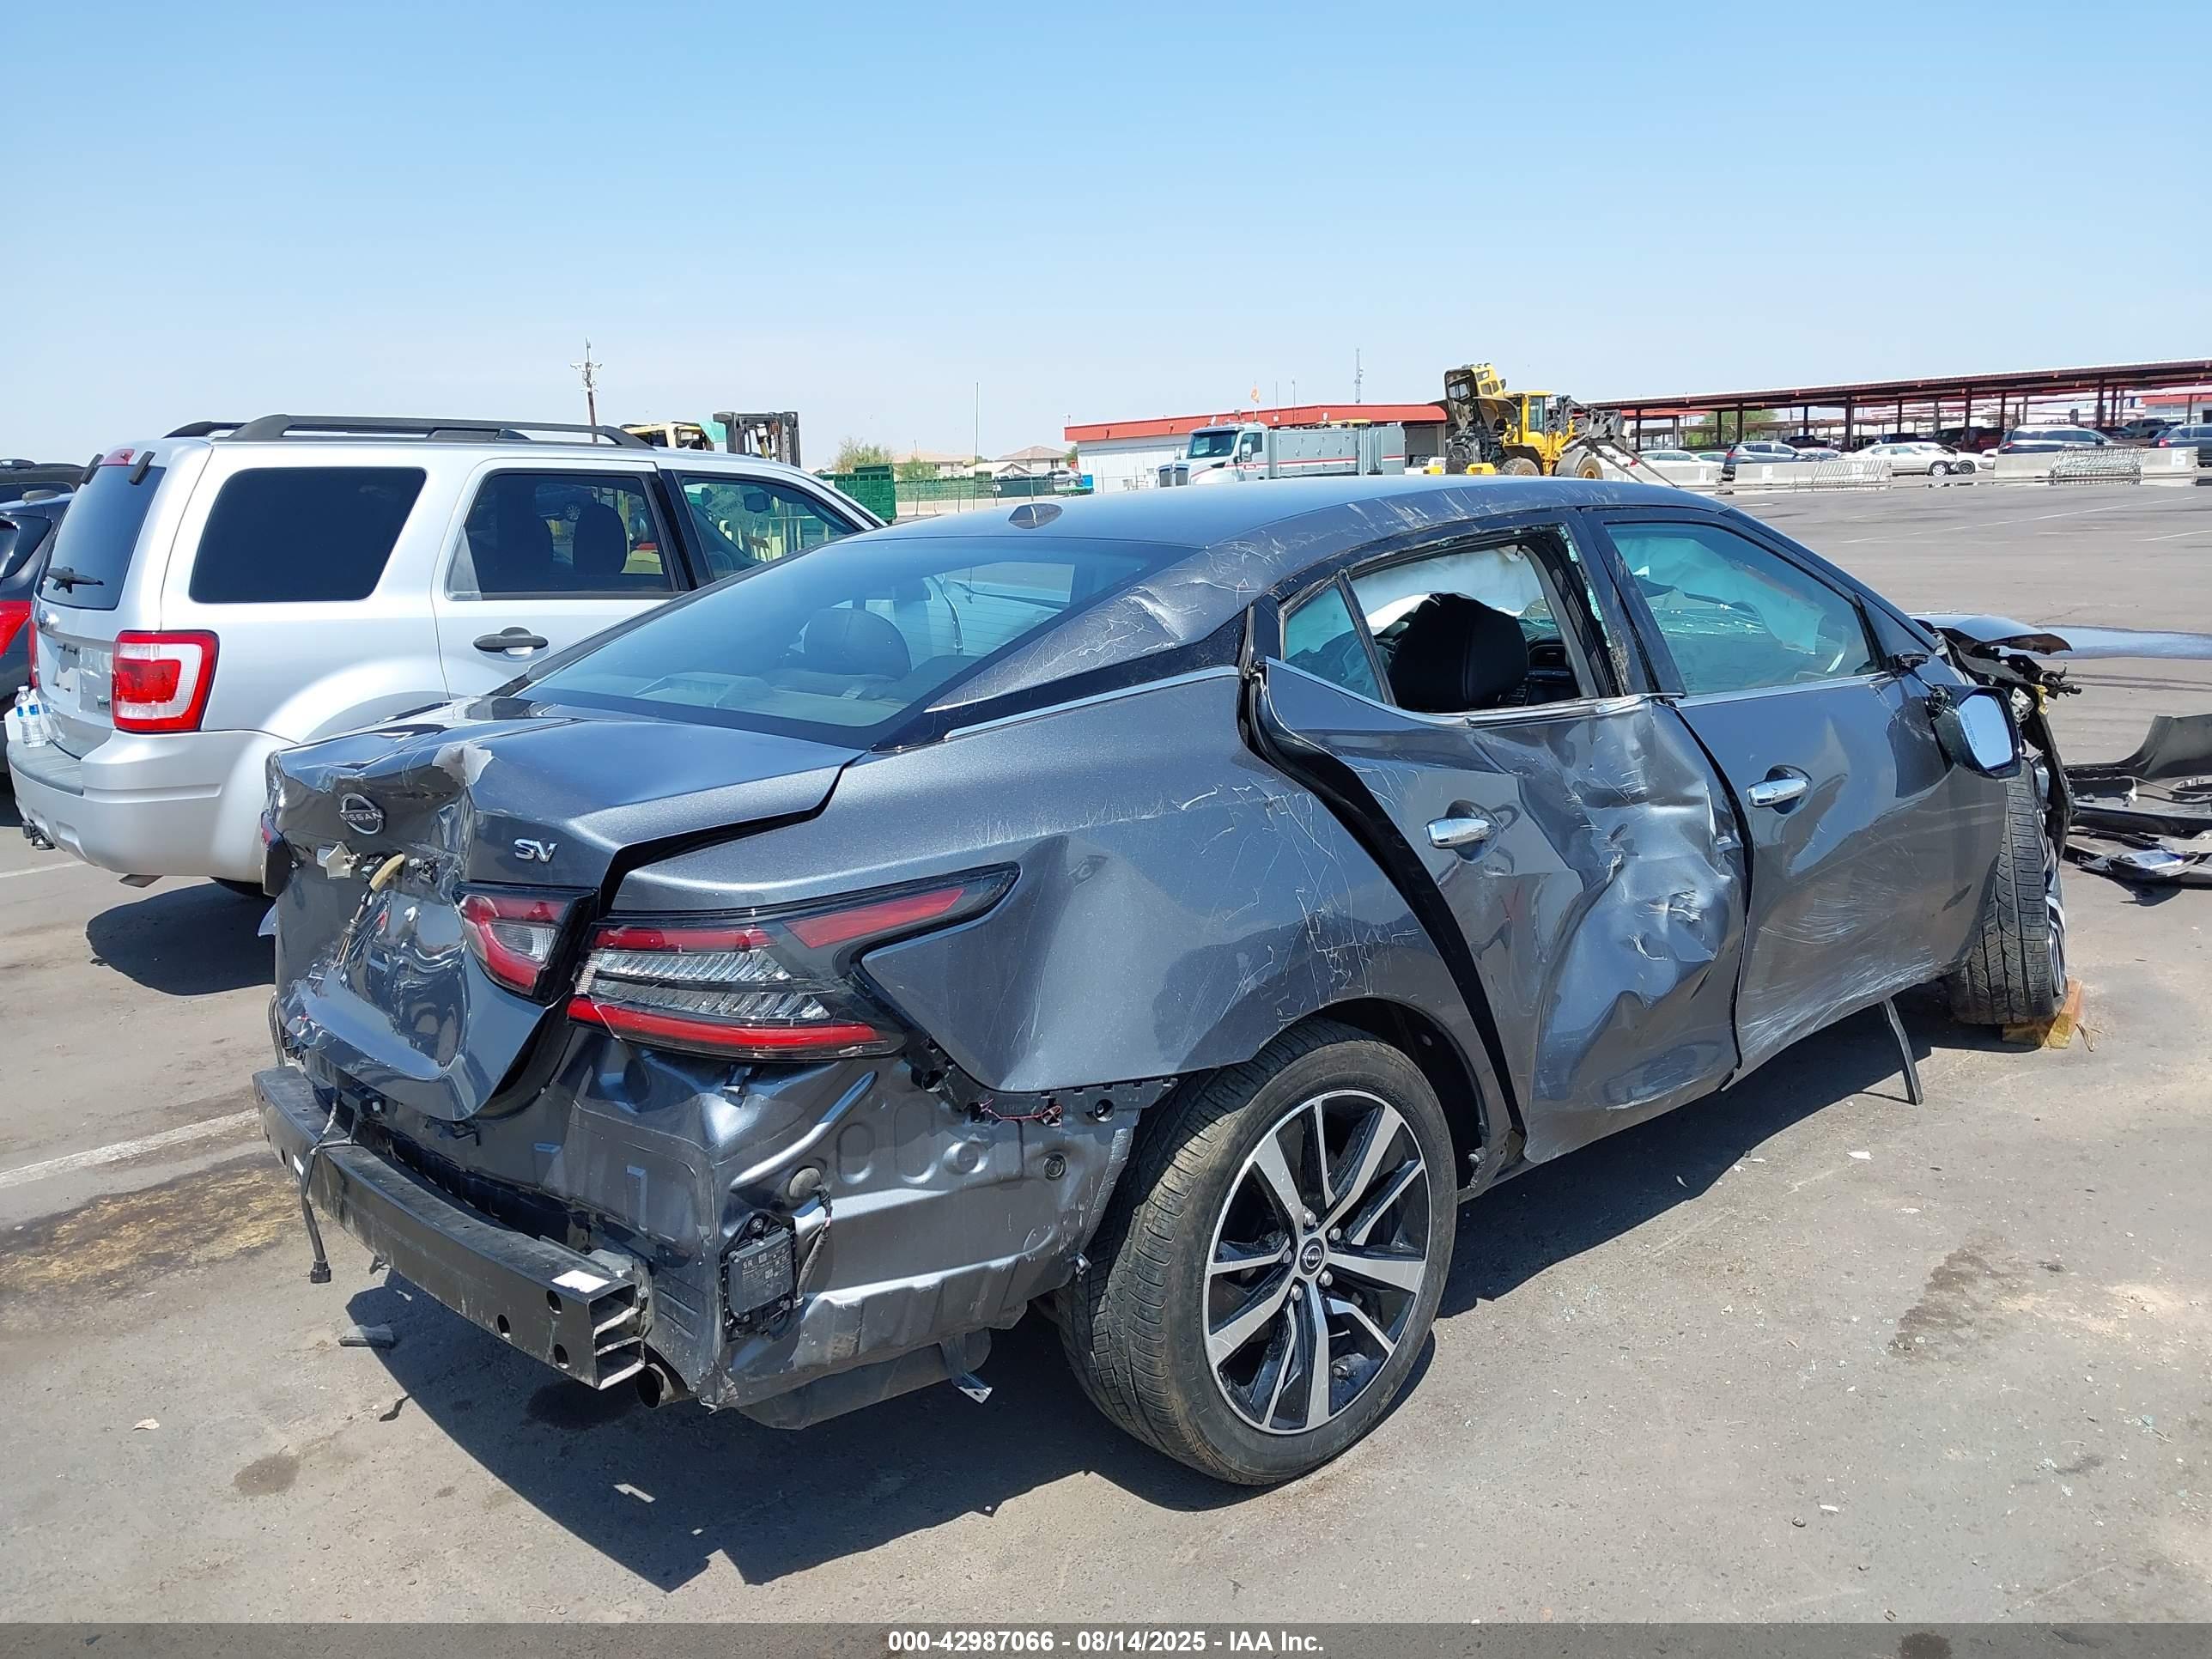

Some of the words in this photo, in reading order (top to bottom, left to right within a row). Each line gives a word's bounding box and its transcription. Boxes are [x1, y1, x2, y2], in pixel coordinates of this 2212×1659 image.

[2172, 449, 2187, 466] 15
[339, 810, 383, 821] NISSAN
[514, 838, 557, 862] SV
